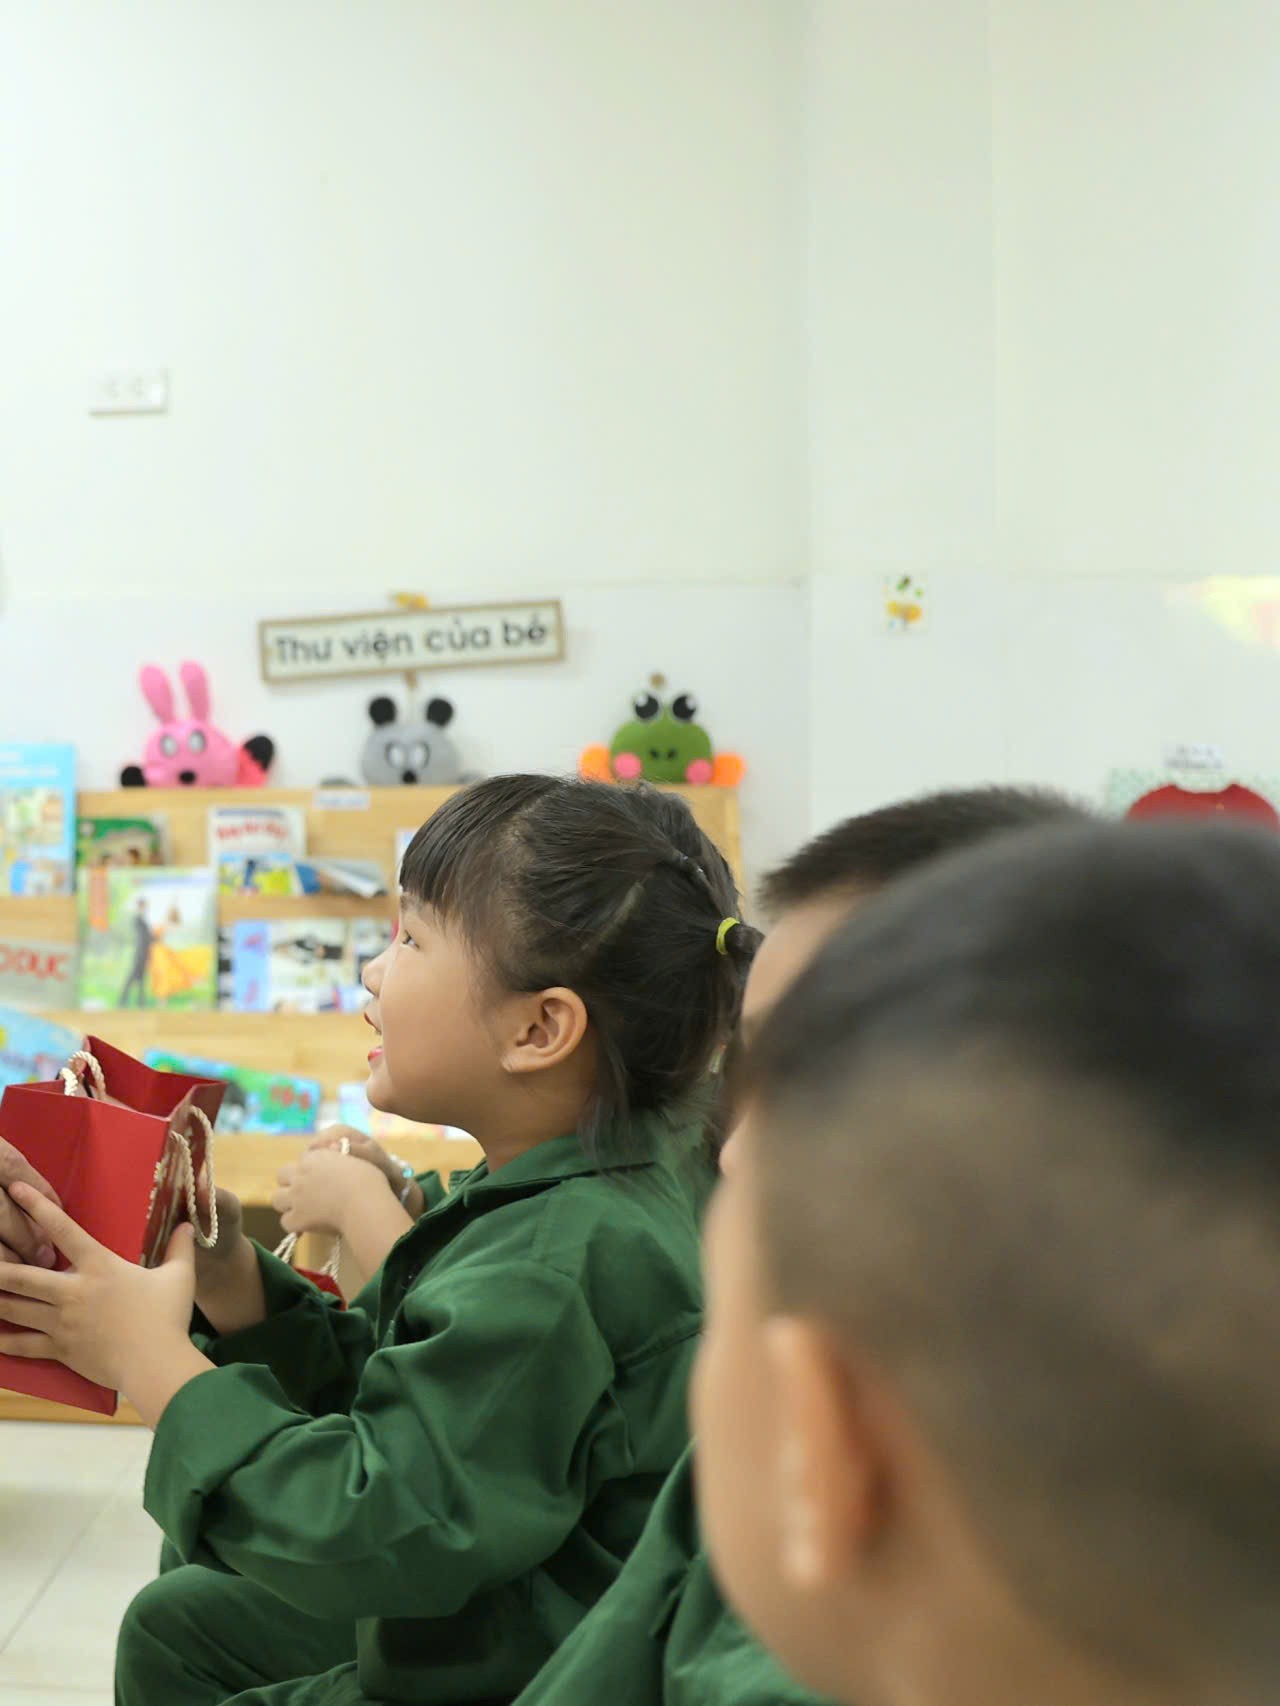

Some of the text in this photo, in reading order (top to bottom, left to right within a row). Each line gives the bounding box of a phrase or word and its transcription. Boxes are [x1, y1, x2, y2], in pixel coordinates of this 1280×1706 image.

[275, 612, 548, 663] Thư viện của bé
